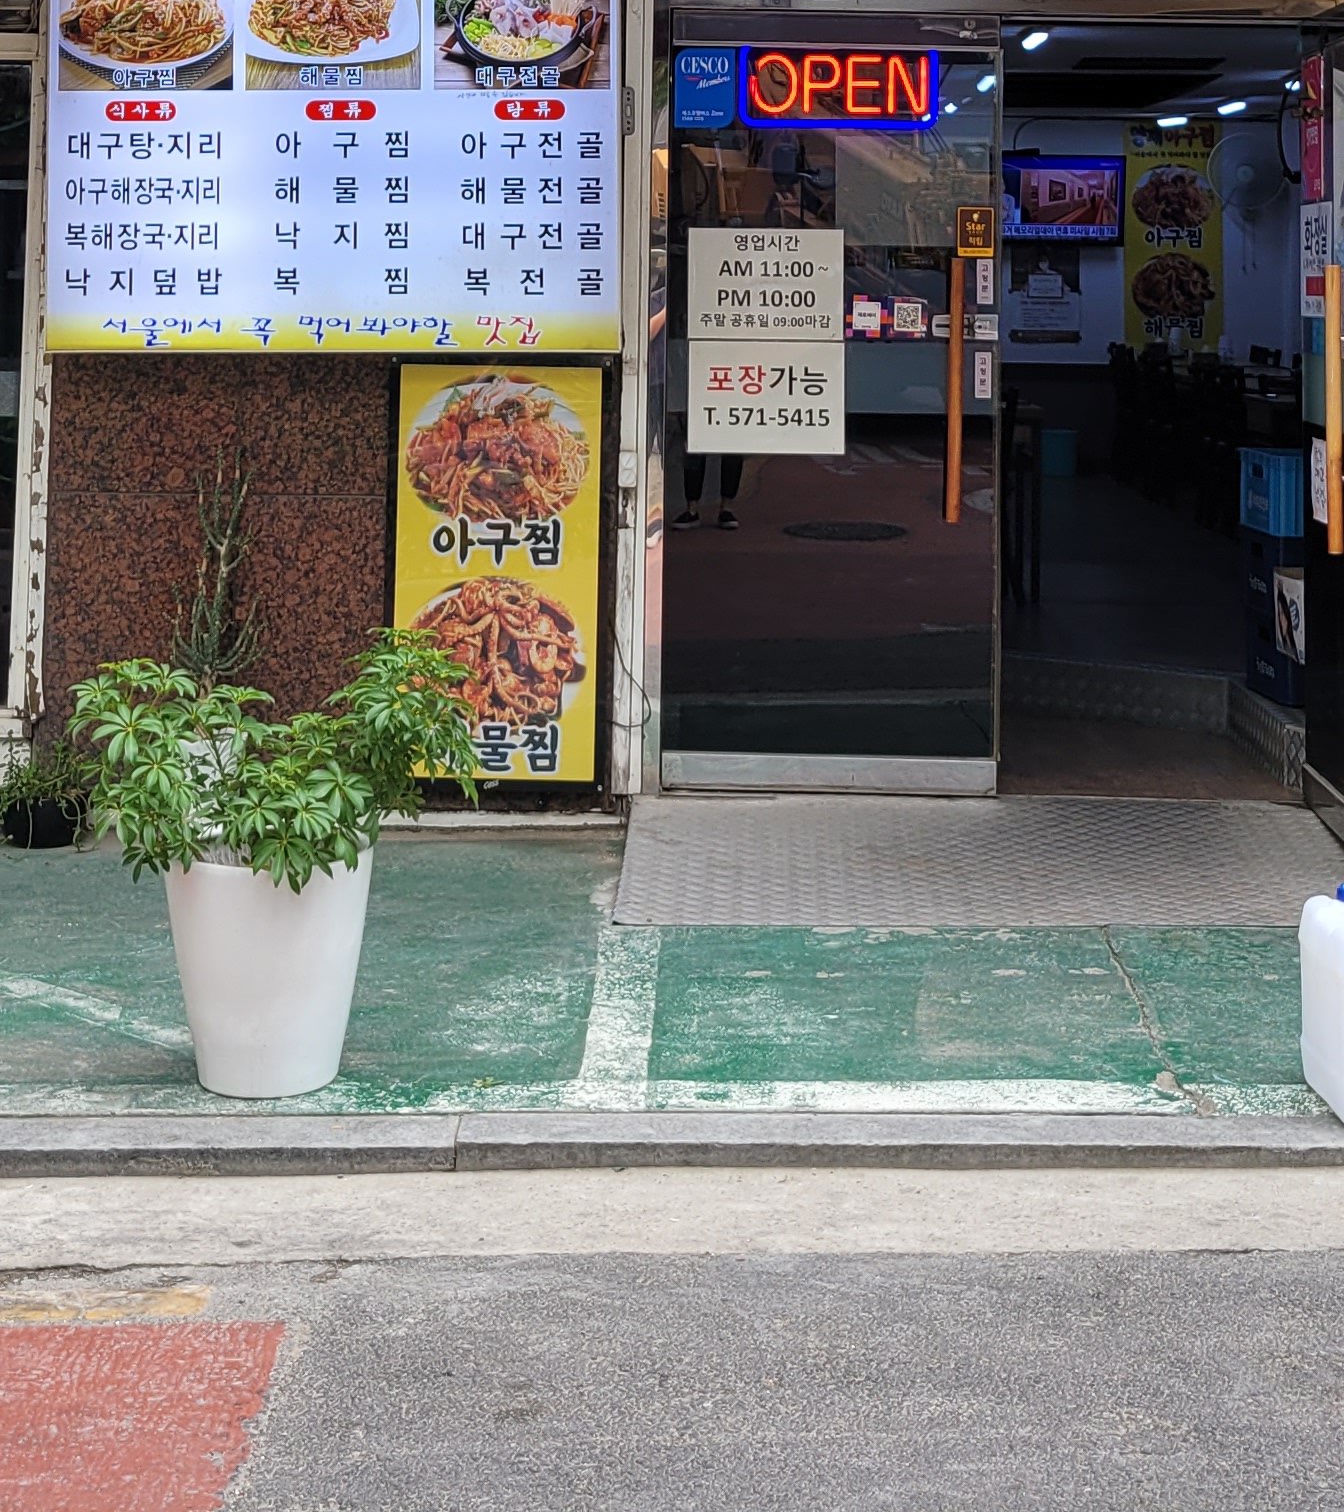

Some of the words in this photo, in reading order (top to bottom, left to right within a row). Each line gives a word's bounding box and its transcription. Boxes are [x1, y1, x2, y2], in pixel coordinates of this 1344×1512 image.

[112, 67, 177, 88] 아구찜
[299, 65, 363, 87] 해물찜
[475, 65, 561, 87] 대구전골
[681, 56, 729, 74] CESCO
[750, 51, 931, 116] OPEN
[67, 131, 223, 160] 대구탕·지리
[460, 130, 604, 160] 아구전골
[65, 176, 222, 206] 아구해장국·지리
[460, 176, 604, 205] 해물전골
[64, 221, 219, 252] 복해장국·지리
[461, 221, 604, 251] 대구전골
[733, 233, 801, 252] 영업시간
[1145, 225, 1203, 249] 아구찜
[1304, 215, 1328, 256] 화장실
[718, 261, 754, 278] AM
[717, 290, 751, 307] PM
[758, 289, 816, 308] 10:00
[102, 316, 222, 347] 서울에서
[241, 315, 276, 347] 꼭
[476, 315, 542, 346] 맛집
[700, 313, 728, 329] 주말
[729, 313, 769, 329] 공휴일
[706, 365, 828, 397] 포장가능
[703, 408, 722, 427] T.
[728, 407, 830, 427] 571-5415
[433, 517, 562, 568] 아구찜
[453, 723, 560, 773] 물찜
